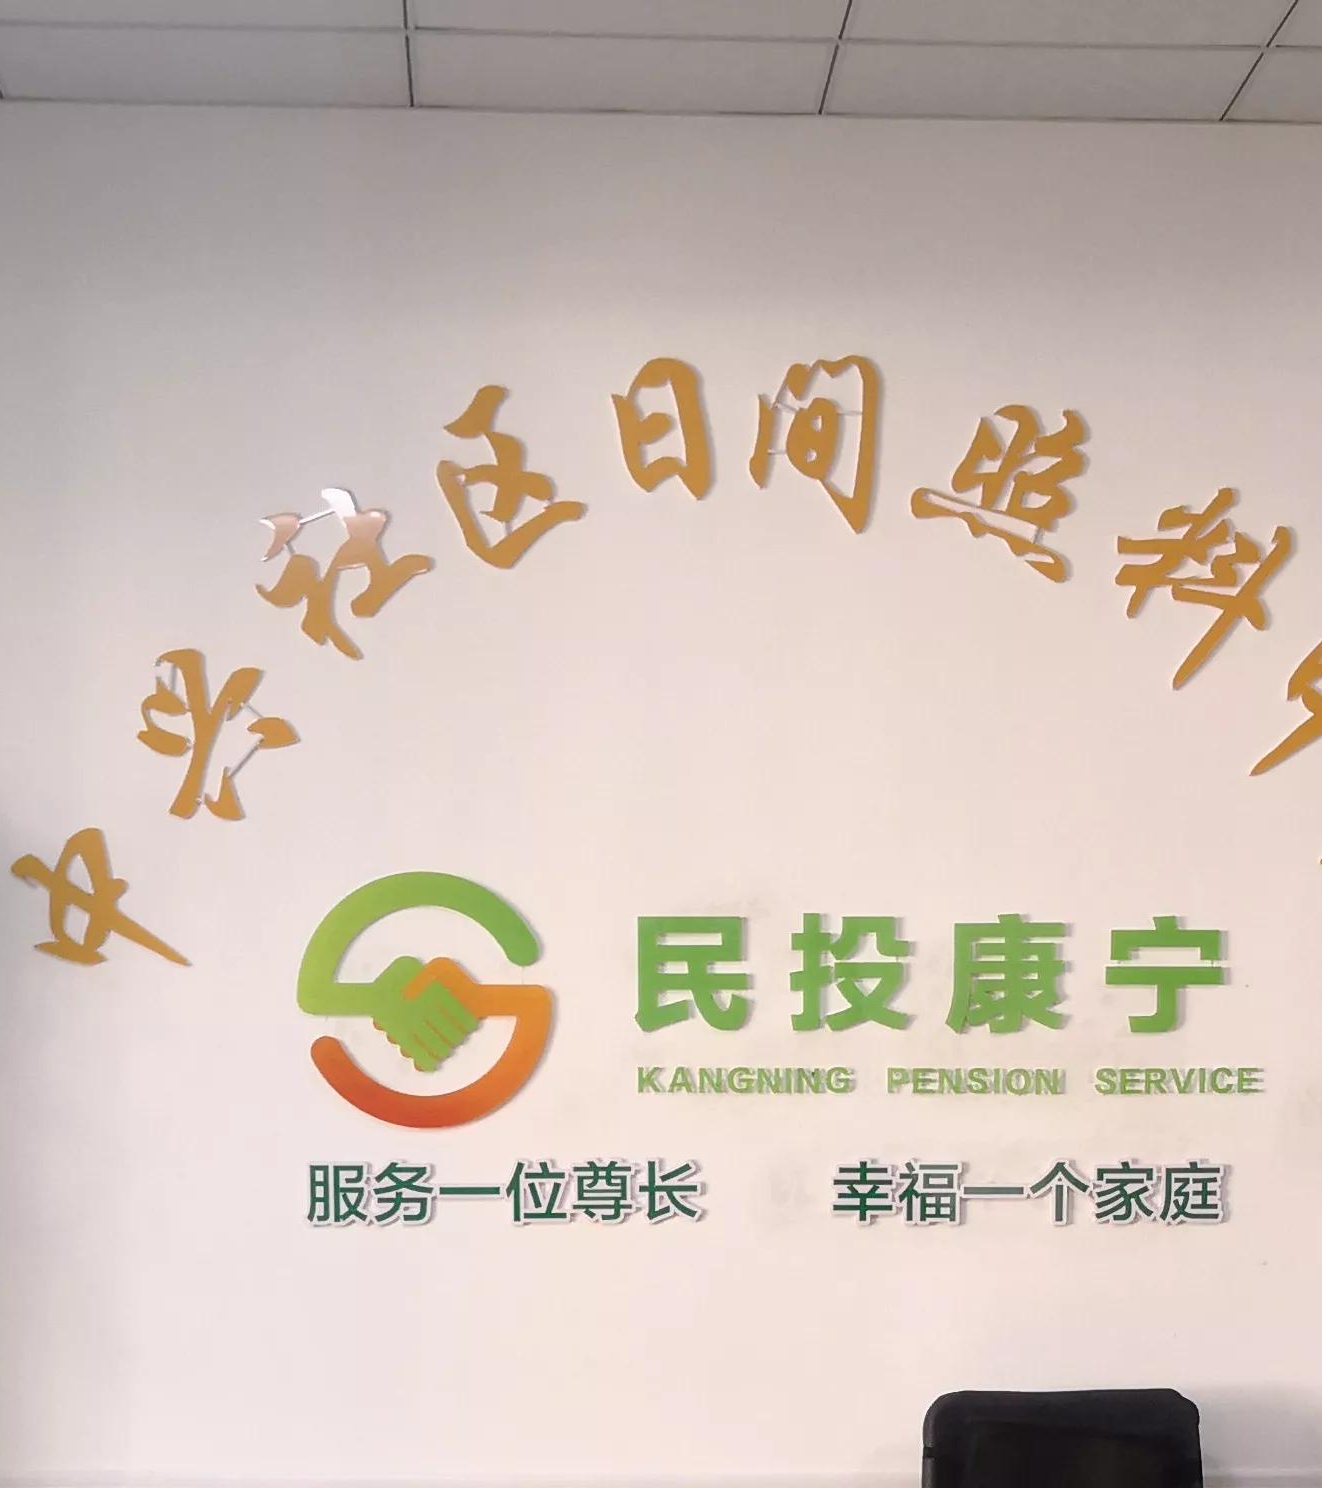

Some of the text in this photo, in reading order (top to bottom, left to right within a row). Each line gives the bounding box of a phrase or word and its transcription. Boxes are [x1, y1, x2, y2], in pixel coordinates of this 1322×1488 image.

[634, 914, 1229, 1034] 民投康宁
[636, 1066, 1261, 1095] KANGNING PENSION SERVICE
[307, 1161, 1221, 1223] 服务一位尊长 幸福一个家庭
